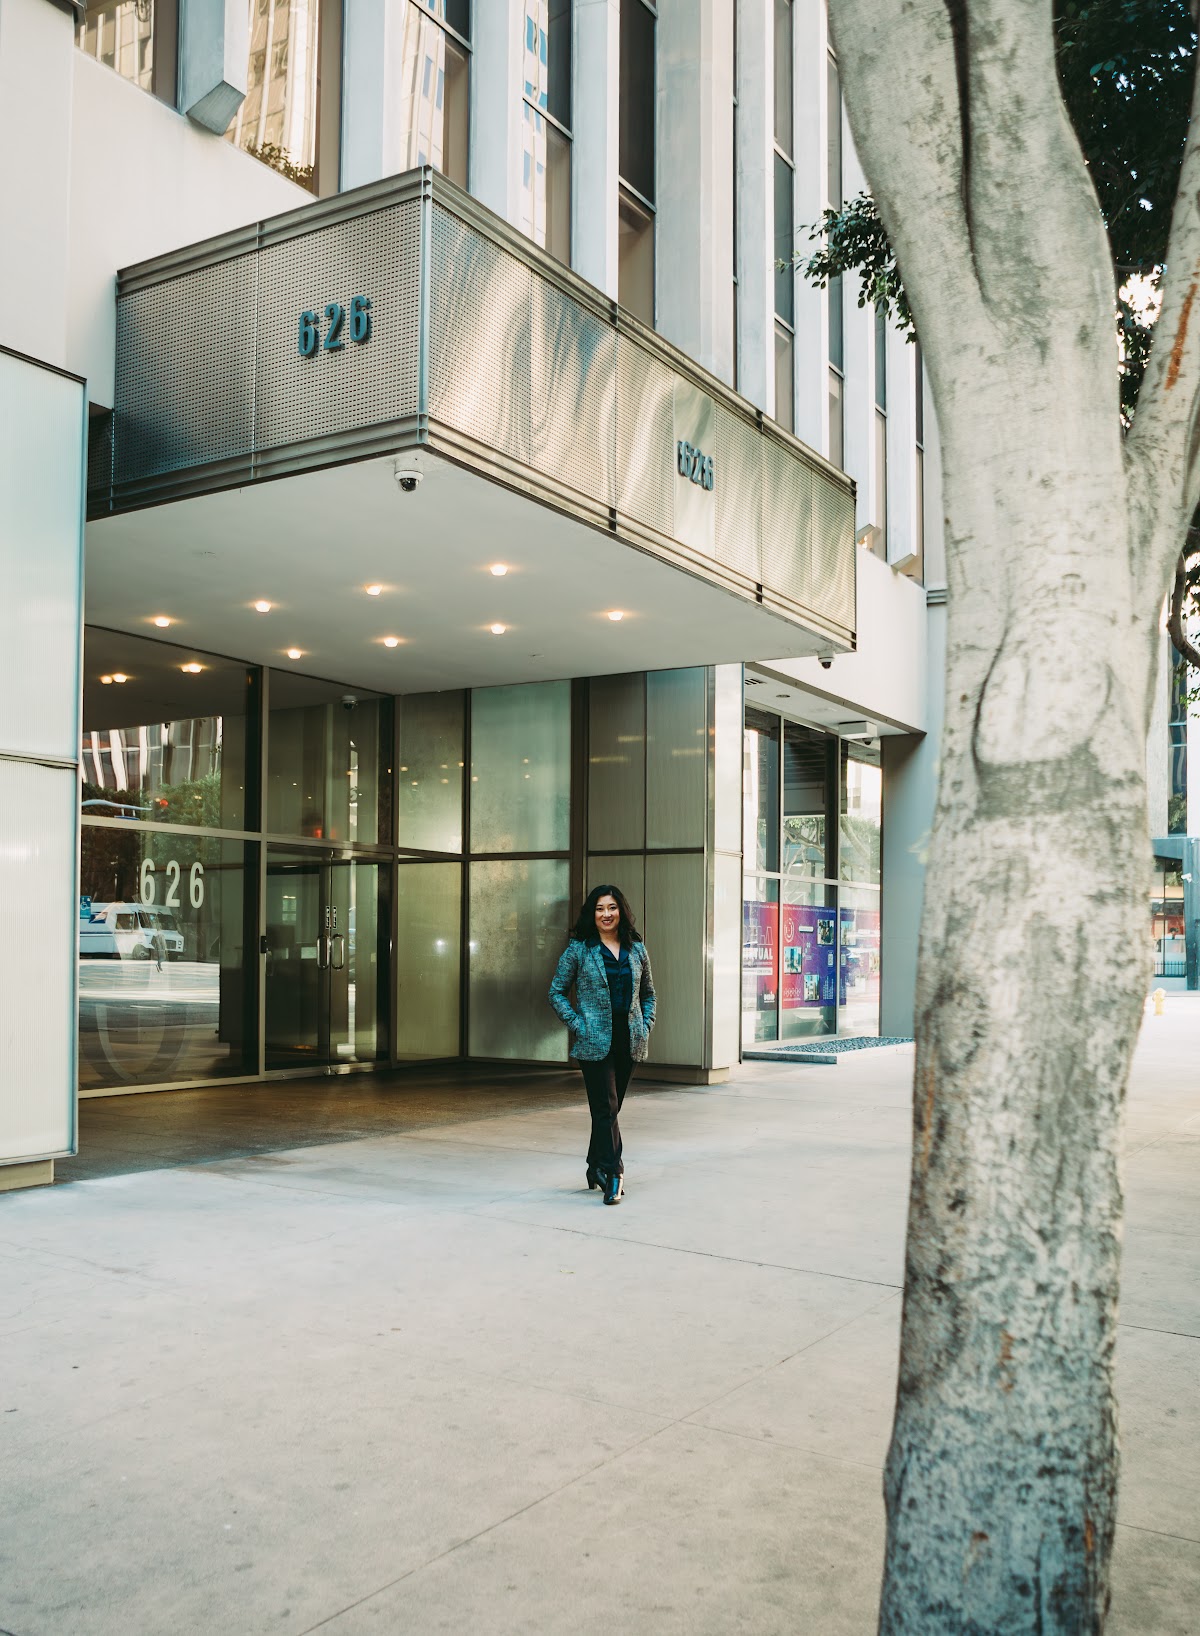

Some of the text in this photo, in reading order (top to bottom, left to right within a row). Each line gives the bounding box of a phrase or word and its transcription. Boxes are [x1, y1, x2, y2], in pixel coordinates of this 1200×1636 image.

[298, 295, 369, 356] 626
[679, 441, 714, 491] 626
[140, 858, 204, 909] 626
